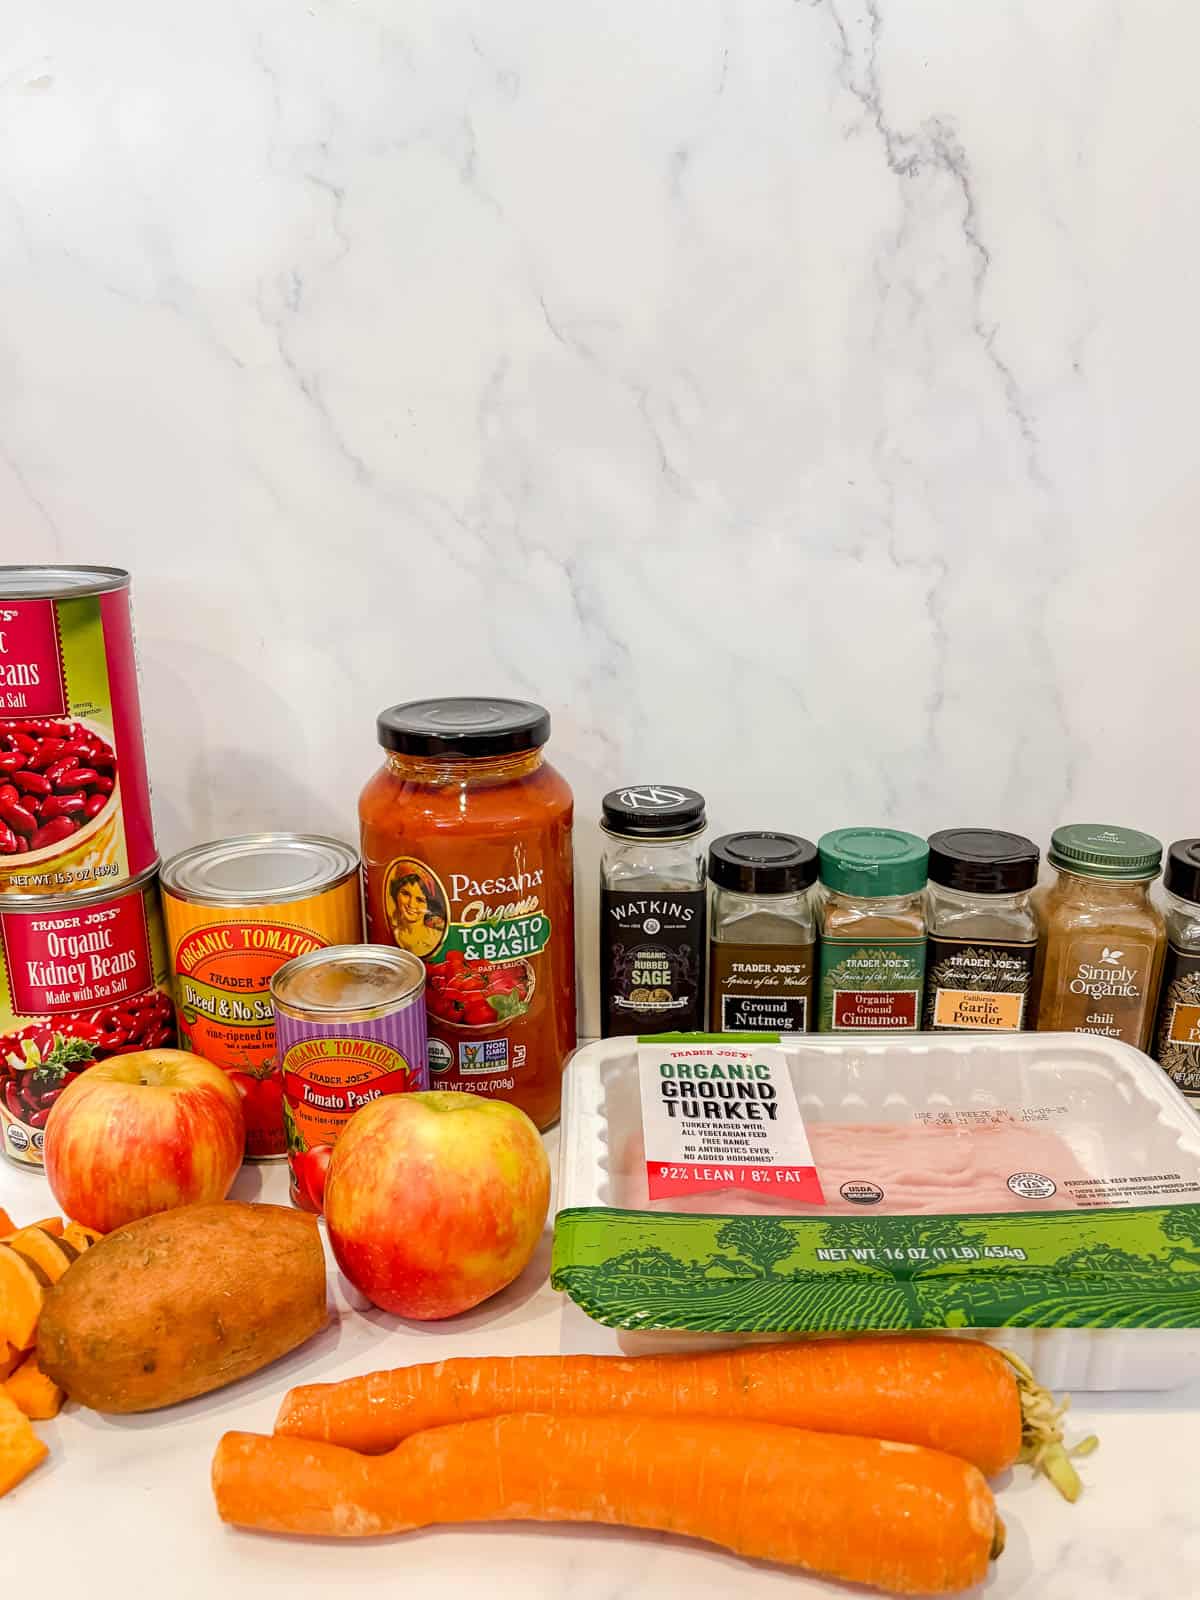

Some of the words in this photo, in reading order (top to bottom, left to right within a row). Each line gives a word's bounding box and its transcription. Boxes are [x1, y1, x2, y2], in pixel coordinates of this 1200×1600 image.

[0, 663, 40, 686] eans
[7, 692, 27, 708] Salt
[9, 875, 30, 886] NET
[54, 872, 73, 884] 15.5
[76, 869, 90, 881] OZ
[461, 895, 539, 924] Organic
[610, 900, 694, 921] WATKINS
[31, 917, 81, 931] TRADER
[458, 917, 542, 944] TOMATO
[47, 925, 113, 960] Organic
[464, 945, 480, 961] &
[483, 935, 539, 960] BASIL
[181, 930, 234, 971] ORGANIC
[26, 961, 86, 986] Kidney
[90, 950, 137, 980] Beans
[634, 960, 669, 969] RUBBED
[731, 963, 771, 972] TRADER
[847, 959, 880, 967] TRADER
[950, 957, 990, 967] TRADER
[209, 973, 254, 988] TRADER
[631, 970, 671, 985] SAGE
[1077, 964, 1138, 985] Simply
[45, 991, 71, 1005] Made
[73, 987, 93, 1001] with
[94, 984, 111, 998] Sea
[112, 978, 128, 993] Salt
[186, 984, 216, 1013] Diced
[219, 999, 230, 1017] &
[233, 1001, 252, 1019] No
[254, 999, 275, 1018] Sal
[741, 1001, 787, 1012] Ground
[855, 994, 895, 1005] Organic
[857, 1005, 892, 1014] Ground
[959, 1001, 999, 1014] Garlic
[735, 1013, 794, 1029] Nutmeg
[842, 1012, 908, 1025] Cinnamon
[953, 1011, 1003, 1025] Powder
[1086, 1013, 1114, 1024] chili
[486, 1041, 505, 1049] NON
[486, 1048, 506, 1056] GMO
[288, 1041, 329, 1070] ORGANIC
[334, 1040, 401, 1069] TOMATOES
[671, 1049, 713, 1058] TRADER
[463, 1060, 506, 1069] VERIFIED
[309, 1072, 342, 1083] TRADER
[433, 1080, 448, 1091] NET
[465, 1082, 475, 1092] 25
[477, 1082, 488, 1091] OZ
[489, 1077, 514, 1093] (708g)
[303, 1084, 344, 1109] Tomato
[346, 1089, 382, 1108] Paste
[661, 1081, 777, 1100] GROUND
[662, 1100, 778, 1120] TURKEY
[681, 1121, 711, 1129] TURKEY
[713, 1122, 740, 1130] RAISED
[698, 1130, 746, 1138] VEGETARIAN
[723, 1138, 750, 1146] RANGE
[698, 1146, 747, 1154] ANTIBIOTICS
[660, 1167, 689, 1180] 92%
[694, 1168, 735, 1182] LEAN
[751, 1170, 771, 1183] 8%
[775, 1171, 801, 1183] FAT
[817, 1248, 847, 1260] NET
[853, 1248, 881, 1260] WT.
[885, 1248, 904, 1260] 16
[908, 1248, 930, 1260] OZ
[933, 1247, 946, 1261] (1
[952, 1246, 979, 1260] LB)
[984, 1246, 1026, 1261] 454g
